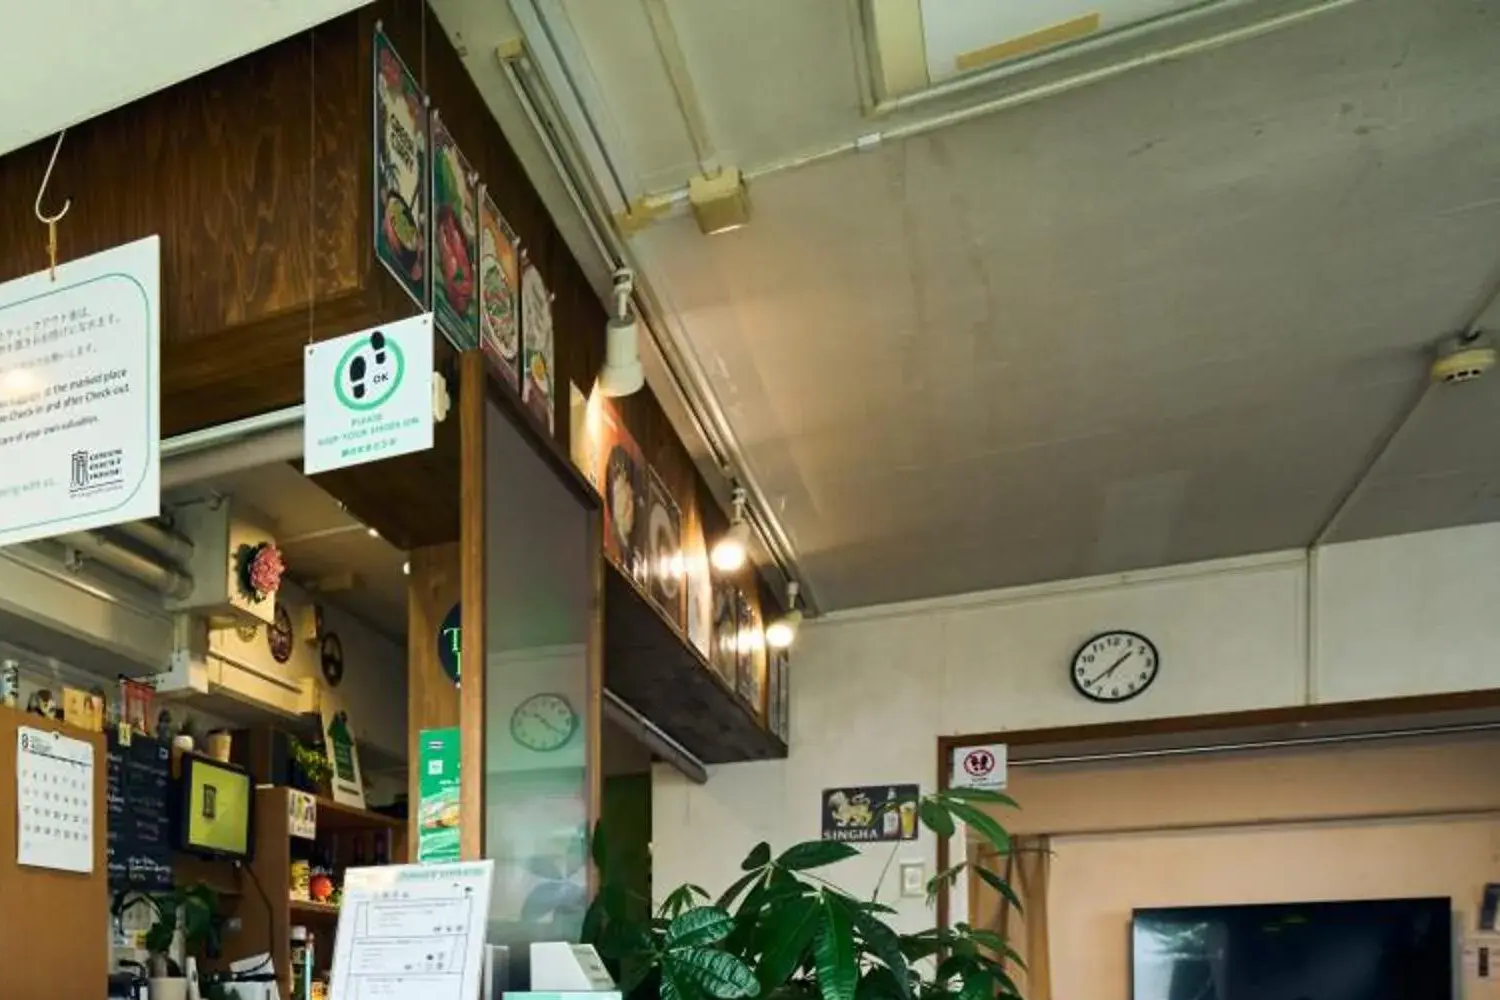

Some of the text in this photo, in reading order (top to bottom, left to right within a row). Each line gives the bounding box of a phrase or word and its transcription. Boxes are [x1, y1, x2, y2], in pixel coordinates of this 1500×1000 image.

[103, 368, 128, 385] place
[373, 373, 389, 384] OK
[85, 386, 110, 402] Check
[21, 733, 29, 749] 8
[823, 828, 878, 840] SINGHA
